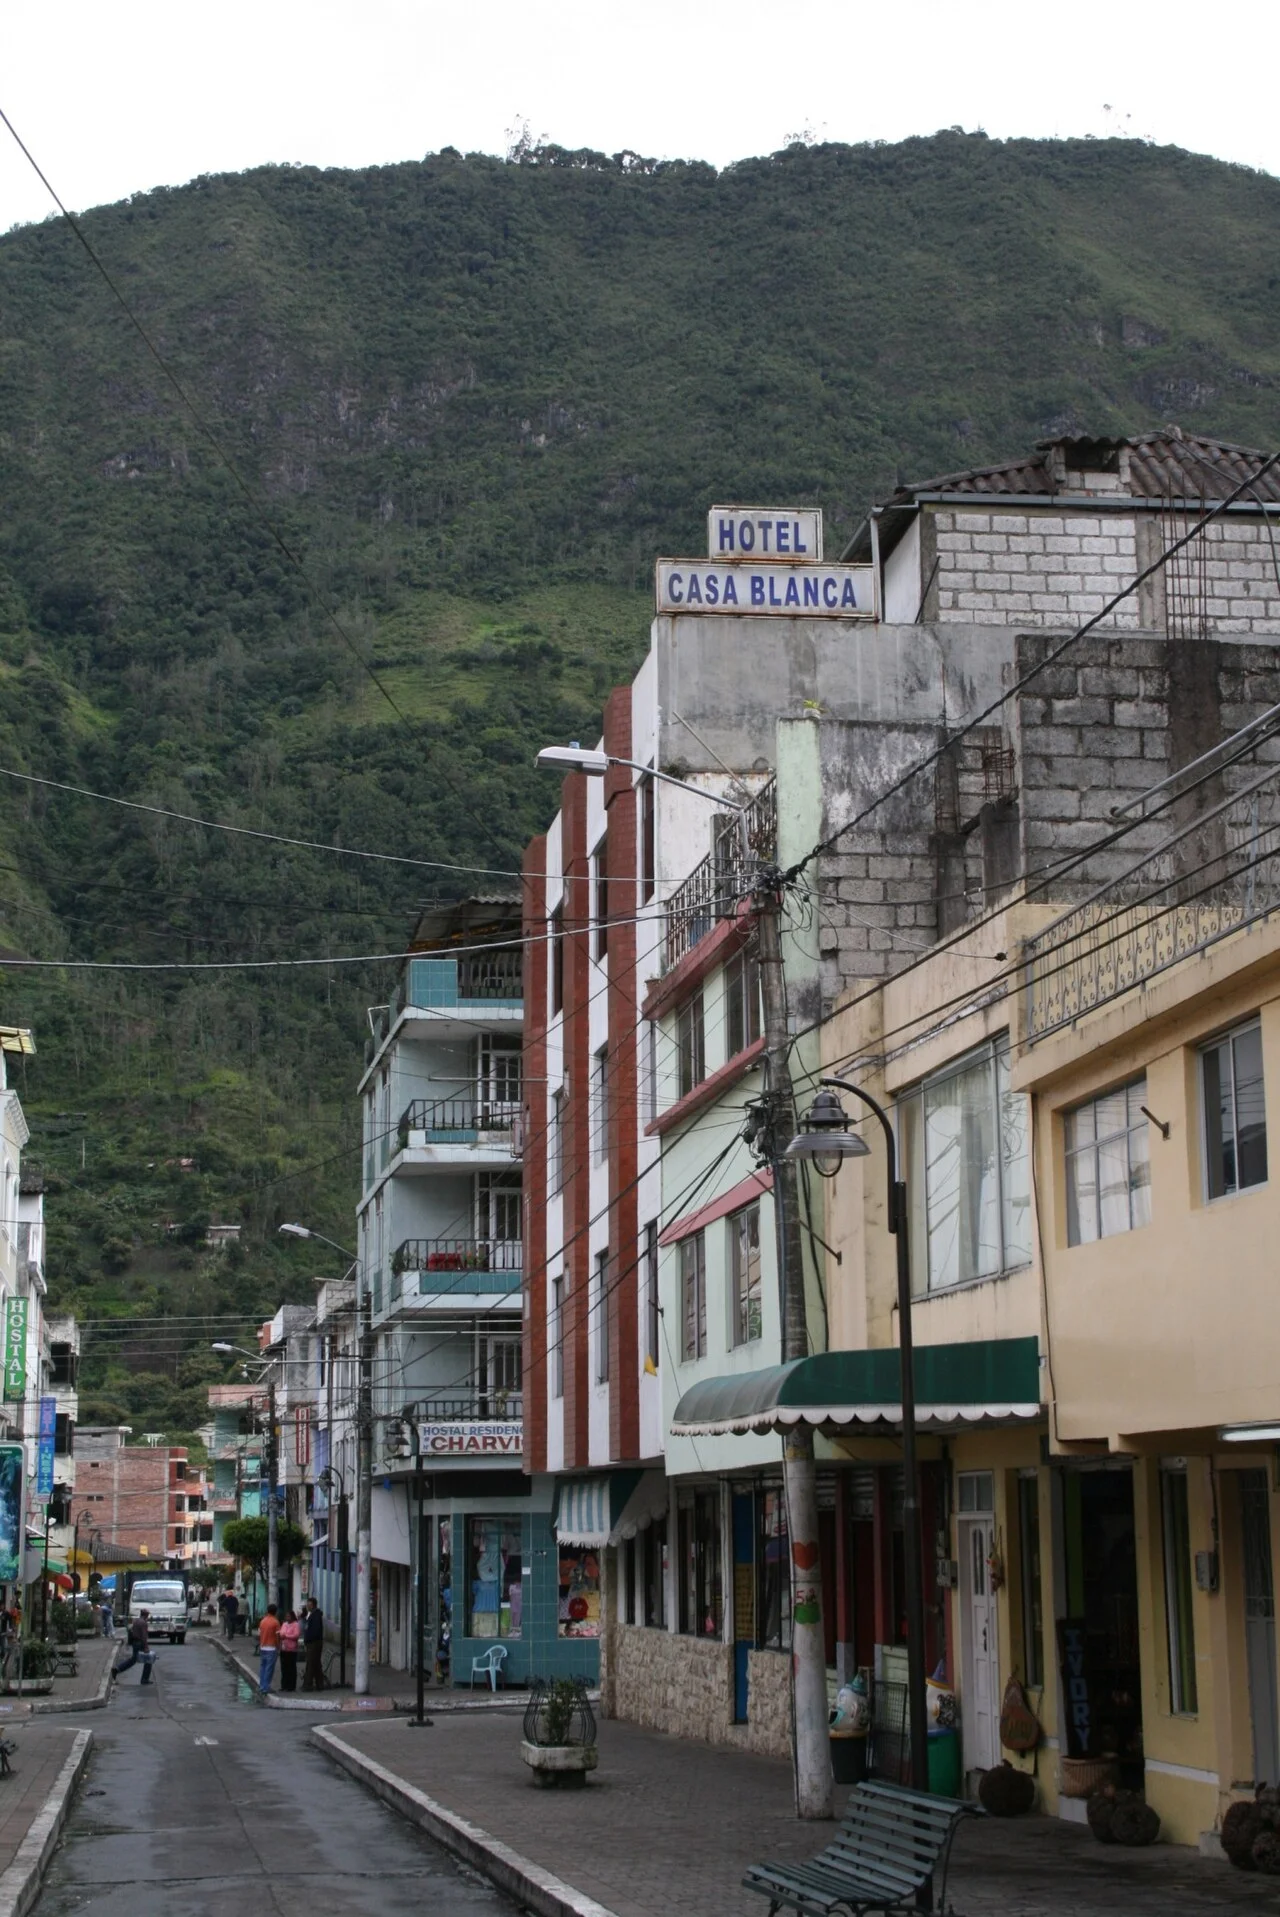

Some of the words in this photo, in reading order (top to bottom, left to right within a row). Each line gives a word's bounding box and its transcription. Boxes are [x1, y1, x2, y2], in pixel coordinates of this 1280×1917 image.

[718, 518, 807, 553] HOTEL
[668, 572, 738, 605] CASA
[750, 575, 858, 609] BLANCA
[8, 1299, 25, 1386] HOSTAL
[423, 1425, 468, 1436] HOSTAL
[430, 1435, 523, 1451] CHARVI
[1063, 1628, 1090, 1752] IVORY
